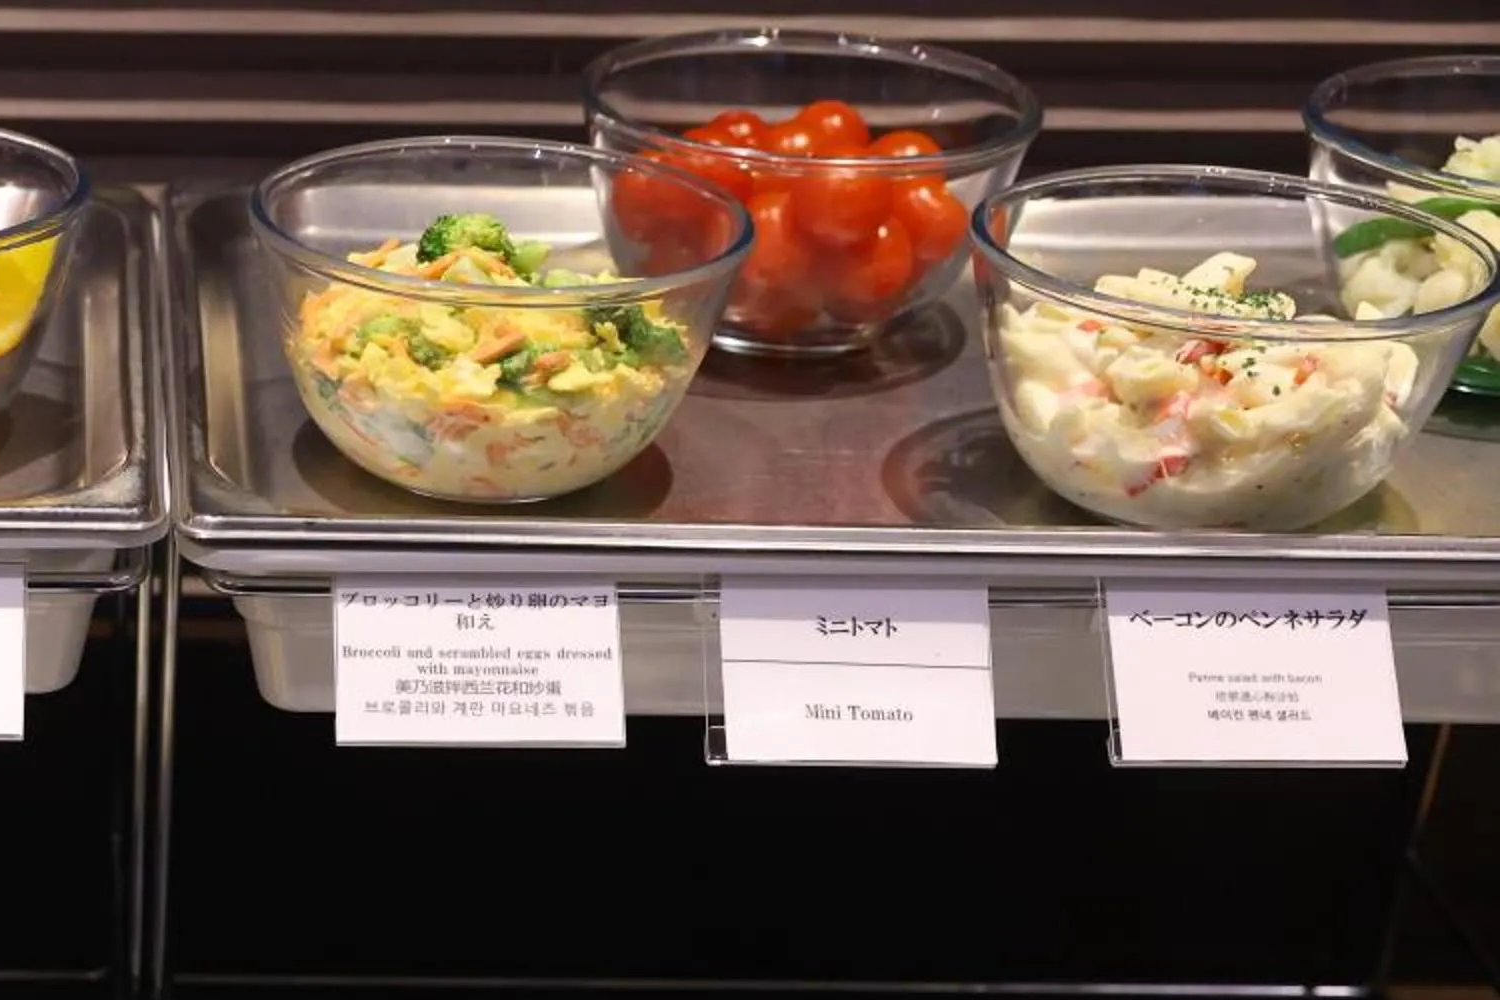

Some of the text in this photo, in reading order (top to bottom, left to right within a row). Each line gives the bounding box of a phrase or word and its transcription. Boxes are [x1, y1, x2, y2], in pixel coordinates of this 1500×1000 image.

[456, 613, 495, 631] 和え
[816, 615, 898, 638] ミニトマト
[1129, 608, 1368, 630] ベーコンのペンネサラダ
[342, 645, 612, 662] Broccoli and scrambled eggs dressed
[417, 663, 539, 678] with mayonnaise
[491, 702, 558, 717] 마요네즈
[805, 703, 913, 722] Mini Tomato
